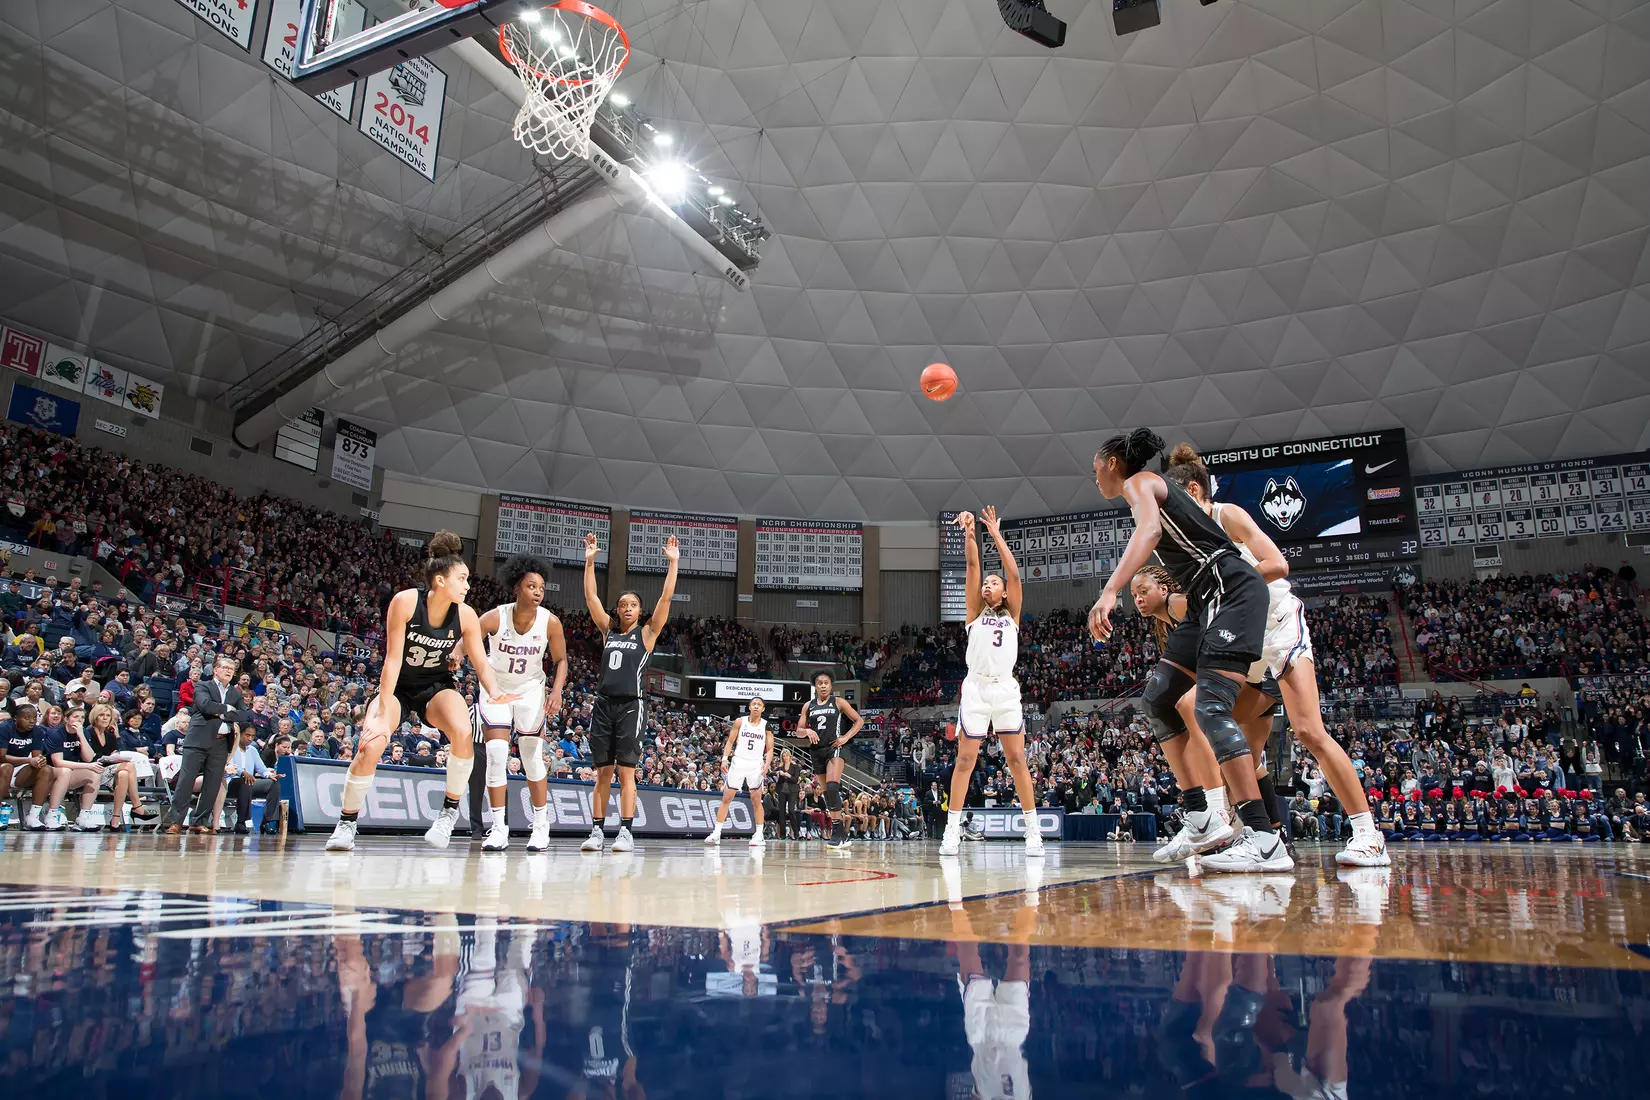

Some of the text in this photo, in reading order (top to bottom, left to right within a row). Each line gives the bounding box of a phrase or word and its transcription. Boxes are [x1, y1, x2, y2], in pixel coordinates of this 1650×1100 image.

[186, 0, 239, 37] MPIONS
[374, 91, 429, 145] 2014
[375, 116, 424, 157] NATIONAL
[369, 127, 427, 172] CHAMPIONS
[88, 372, 125, 394] Tulsa
[109, 423, 126, 436] 222
[349, 425, 367, 435] COACH
[342, 438, 369, 459] 873
[1202, 435, 1381, 465] VERSITY OF CONNECTICUT
[1462, 470, 1493, 478] UCONN
[1498, 465, 1539, 475] HUSKIES
[1561, 460, 1594, 468] HONOR
[1599, 480, 1613, 493] 31
[1631, 477, 1645, 490] 14
[1510, 490, 1522, 501] 20
[1540, 487, 1551, 499] 31
[1569, 484, 1582, 496] 23
[1424, 498, 1435, 510] 32
[1455, 496, 1461, 507] 3
[538, 506, 565, 514] SEASON
[568, 510, 609, 519] CHAMPIONS
[579, 504, 609, 513] CONFERENCE
[550, 514, 608, 528] 1994 1997
[790, 521, 857, 529] CHAMPIONSHIP
[1046, 515, 1077, 523] HUSKIES
[1573, 517, 1587, 529] 15
[1600, 514, 1623, 527] 24
[631, 524, 735, 539] 1989 1991 1994 1995 1996 1997 1998
[1482, 524, 1499, 537] 30
[1515, 522, 1524, 534] 3
[1541, 519, 1558, 532] CD
[548, 526, 608, 539] 2001 2002 2004
[758, 533, 769, 541] 1989
[773, 533, 784, 541] 1990
[789, 534, 799, 542] 1991
[819, 535, 830, 543] 1993
[1074, 533, 1089, 544] 42
[1098, 531, 1110, 542] 25
[1122, 529, 1132, 540] 33
[1425, 530, 1441, 542] 23
[1458, 527, 1466, 538] 4
[564, 539, 576, 547] 2011
[646, 536, 658, 544] 2000
[693, 539, 705, 547] 2005
[708, 540, 720, 548] 2006
[1030, 538, 1042, 549] 21
[1051, 535, 1065, 546] 52
[9, 543, 30, 555] 221
[547, 548, 559, 556] 2019
[773, 544, 784, 552] 1997
[804, 545, 815, 553] 1999
[834, 546, 845, 554] 2001
[1402, 540, 1417, 554] 32
[646, 547, 735, 560] 2010 2014 2015 2016
[757, 554, 769, 562] 2003
[772, 555, 785, 563] 2004
[788, 555, 800, 563] 2005
[818, 556, 830, 564] 2007
[630, 557, 641, 565] 2017
[757, 565, 769, 573] 2010
[772, 565, 784, 573] 2011
[803, 566, 815, 574] 2013
[834, 567, 845, 575] 2015
[1318, 574, 1338, 582] Gampel
[407, 631, 455, 648] KNIGHTS
[992, 630, 1003, 647] 3
[499, 643, 541, 655] UCONN
[605, 641, 638, 649] KNIGHTS
[355, 648, 370, 658] 122
[405, 645, 443, 668] 32
[508, 657, 528, 675] 13
[609, 650, 623, 670] 0
[1517, 698, 1537, 706] 104
[809, 708, 836, 717] KNIGHTS
[817, 716, 827, 730] 2
[9, 737, 33, 745] UCONN
[741, 731, 764, 741] UCONN
[747, 739, 754, 751] 5
[659, 796, 751, 830] GEICO
[971, 814, 1060, 832] GEICO
